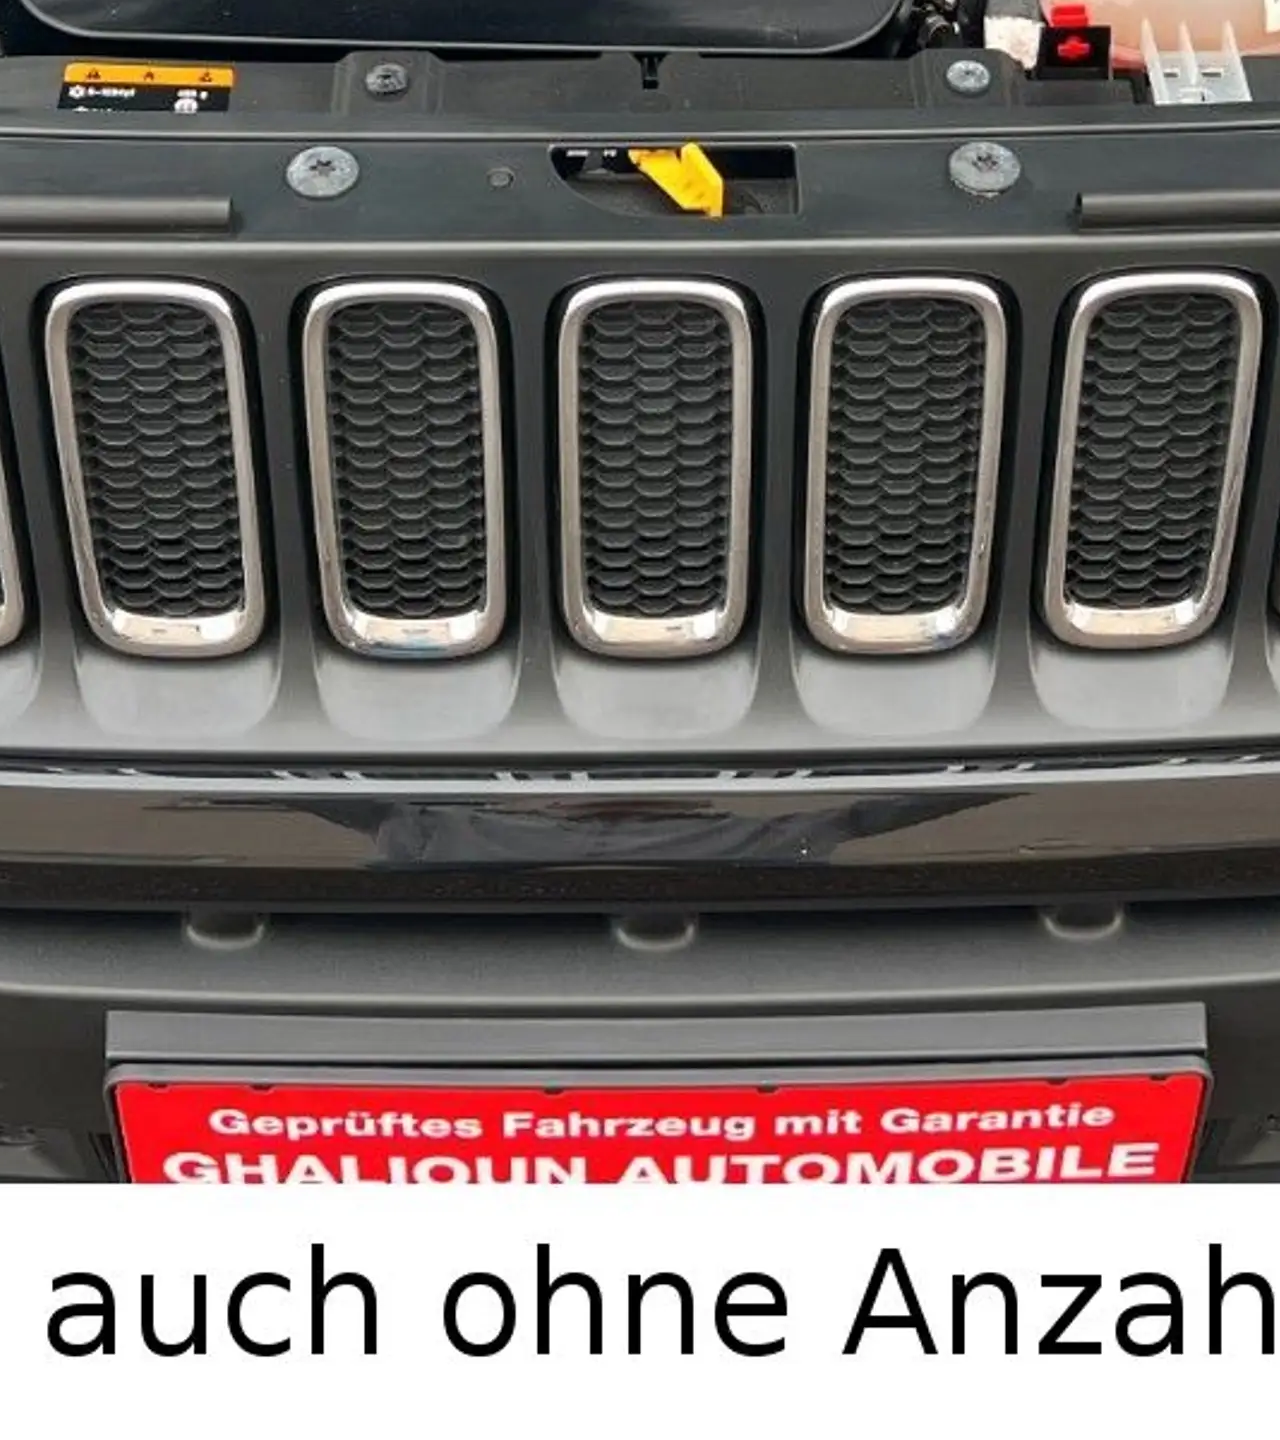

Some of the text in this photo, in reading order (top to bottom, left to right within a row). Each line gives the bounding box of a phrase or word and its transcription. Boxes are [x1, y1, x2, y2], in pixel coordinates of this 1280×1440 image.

[209, 1102, 1116, 1141] Geprüftes Fahrzeug mit Garantie
[163, 1142, 1160, 1184] GHALIOUN AUTOMOBILE
